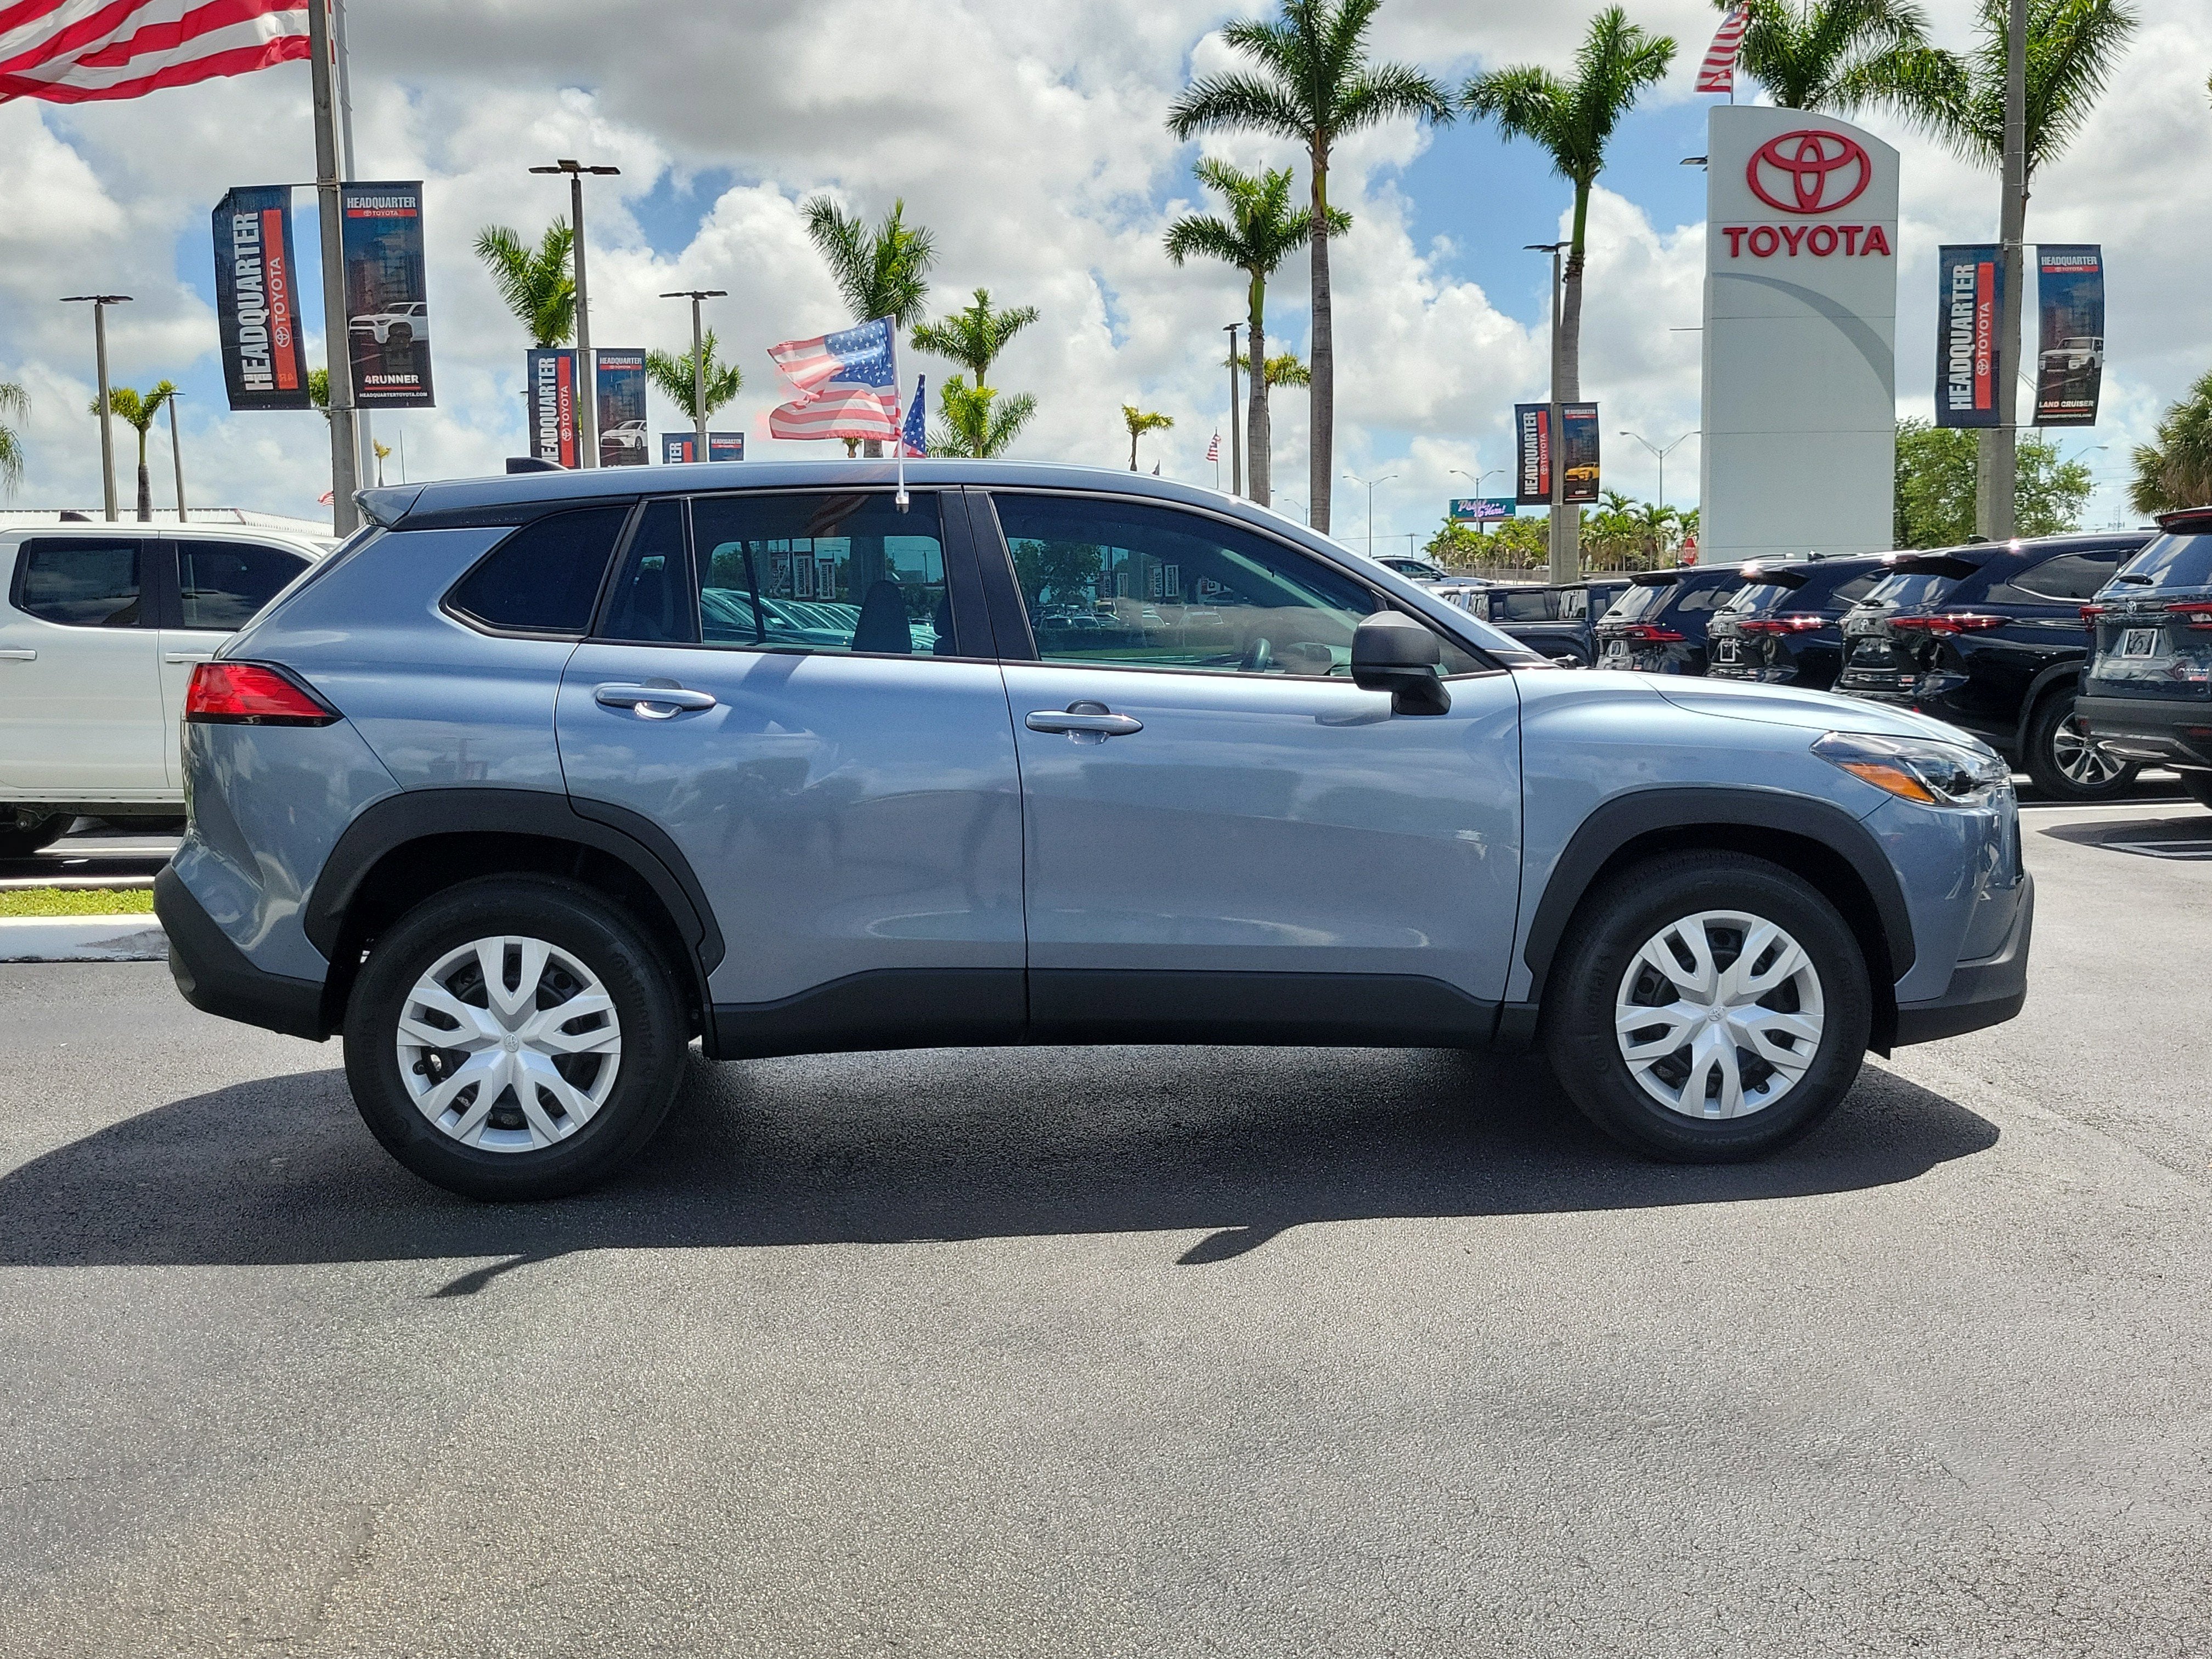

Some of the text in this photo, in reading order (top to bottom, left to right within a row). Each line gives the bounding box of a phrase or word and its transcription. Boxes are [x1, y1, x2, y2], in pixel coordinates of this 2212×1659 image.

[347, 197, 416, 209] HEADQUARTER
[1722, 225, 1891, 258] TOYOTA
[2041, 256, 2097, 266] HEADQUARTER
[233, 212, 273, 391] HEADQUARTER
[270, 257, 284, 325] TOYOTA
[1949, 264, 1975, 410] HEADQUARTER
[1978, 302, 1990, 357] TOYOTA
[364, 375, 419, 384] 4RUNNER
[559, 386, 569, 426] TOYOTA
[1523, 413, 1539, 495] HEADQUARTER
[1684, 547, 1695, 558] STOP
